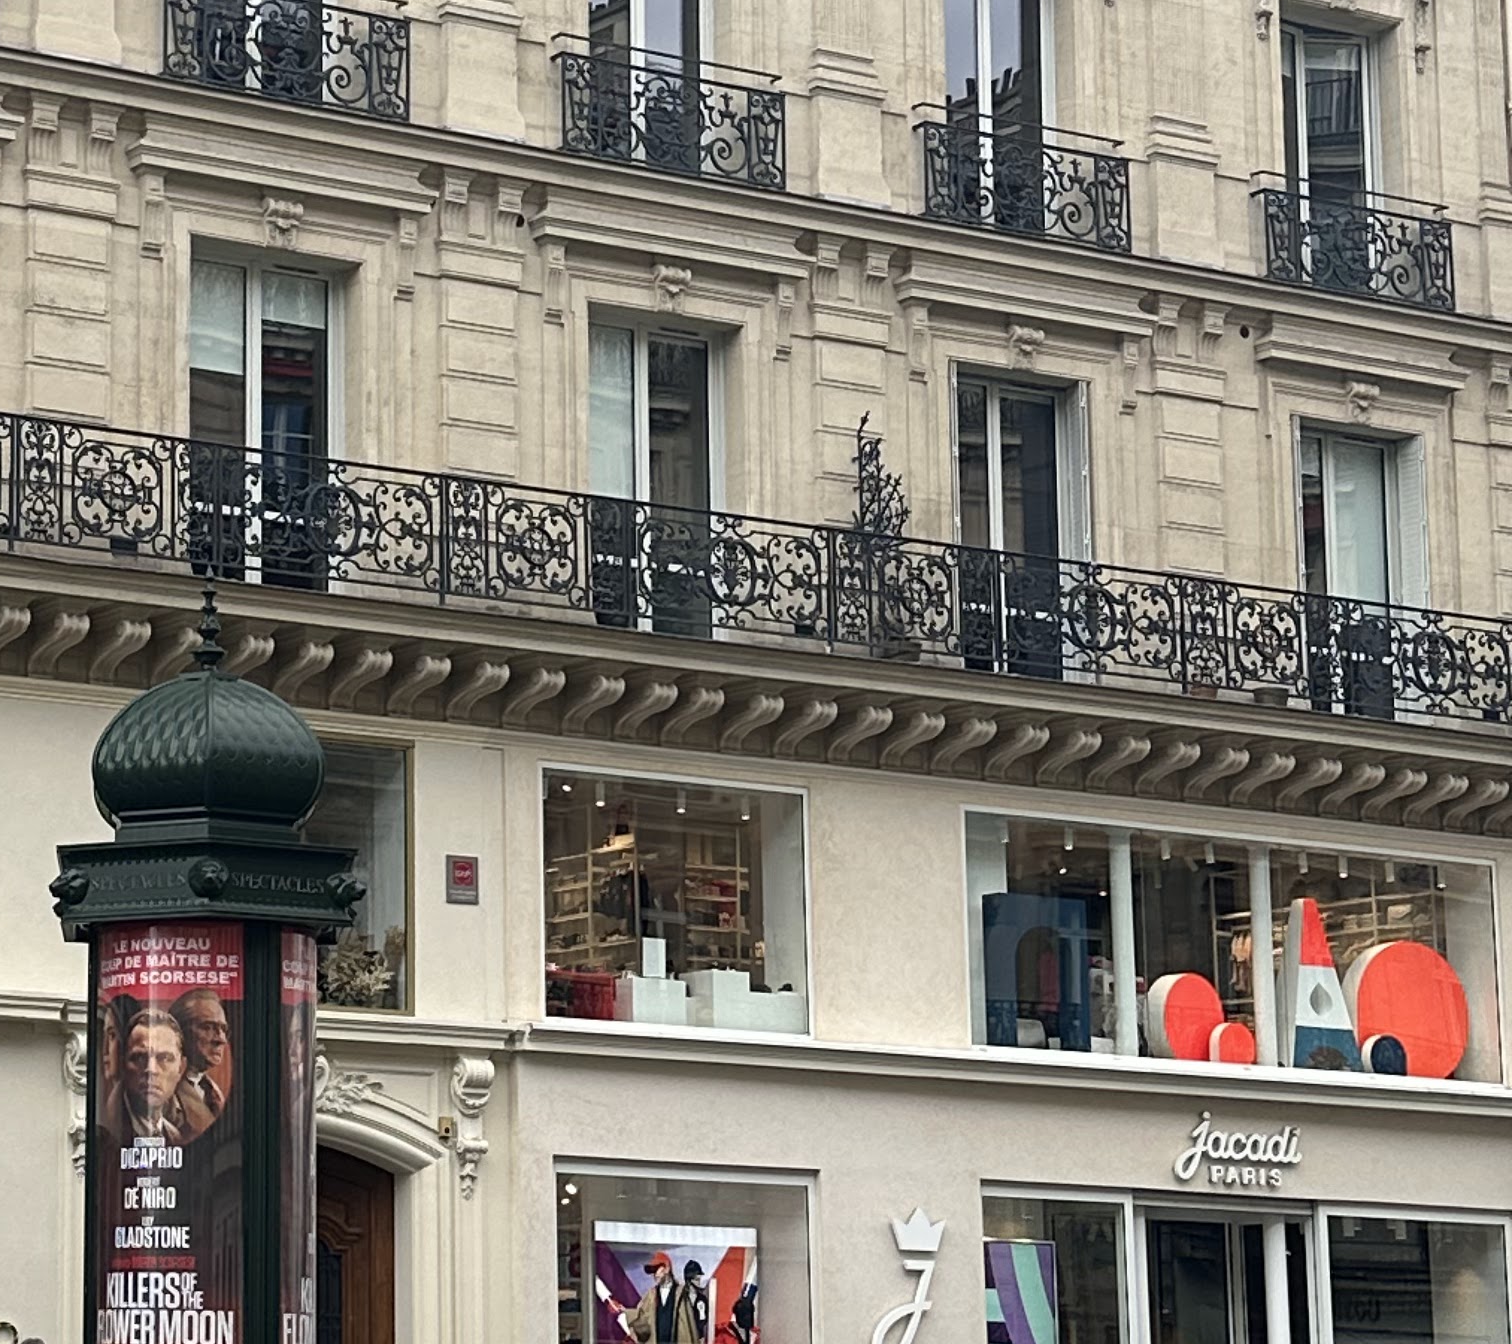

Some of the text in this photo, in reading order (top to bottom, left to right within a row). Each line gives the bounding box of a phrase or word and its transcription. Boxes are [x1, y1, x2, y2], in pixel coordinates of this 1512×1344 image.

[230, 872, 325, 894] SPECTACLES
[130, 938, 211, 952] NOUVEAU
[125, 955, 141, 970] DE
[216, 955, 239, 968] DE
[1174, 1111, 1303, 1181] jacadi
[120, 1147, 183, 1169] DICAPRIO
[1208, 1165, 1283, 1187] PARIS
[124, 1186, 177, 1209] DE NIRO
[114, 1226, 191, 1248] GLADSTONE
[107, 1271, 198, 1309] KILLERS OF
[182, 1290, 204, 1309] THE
